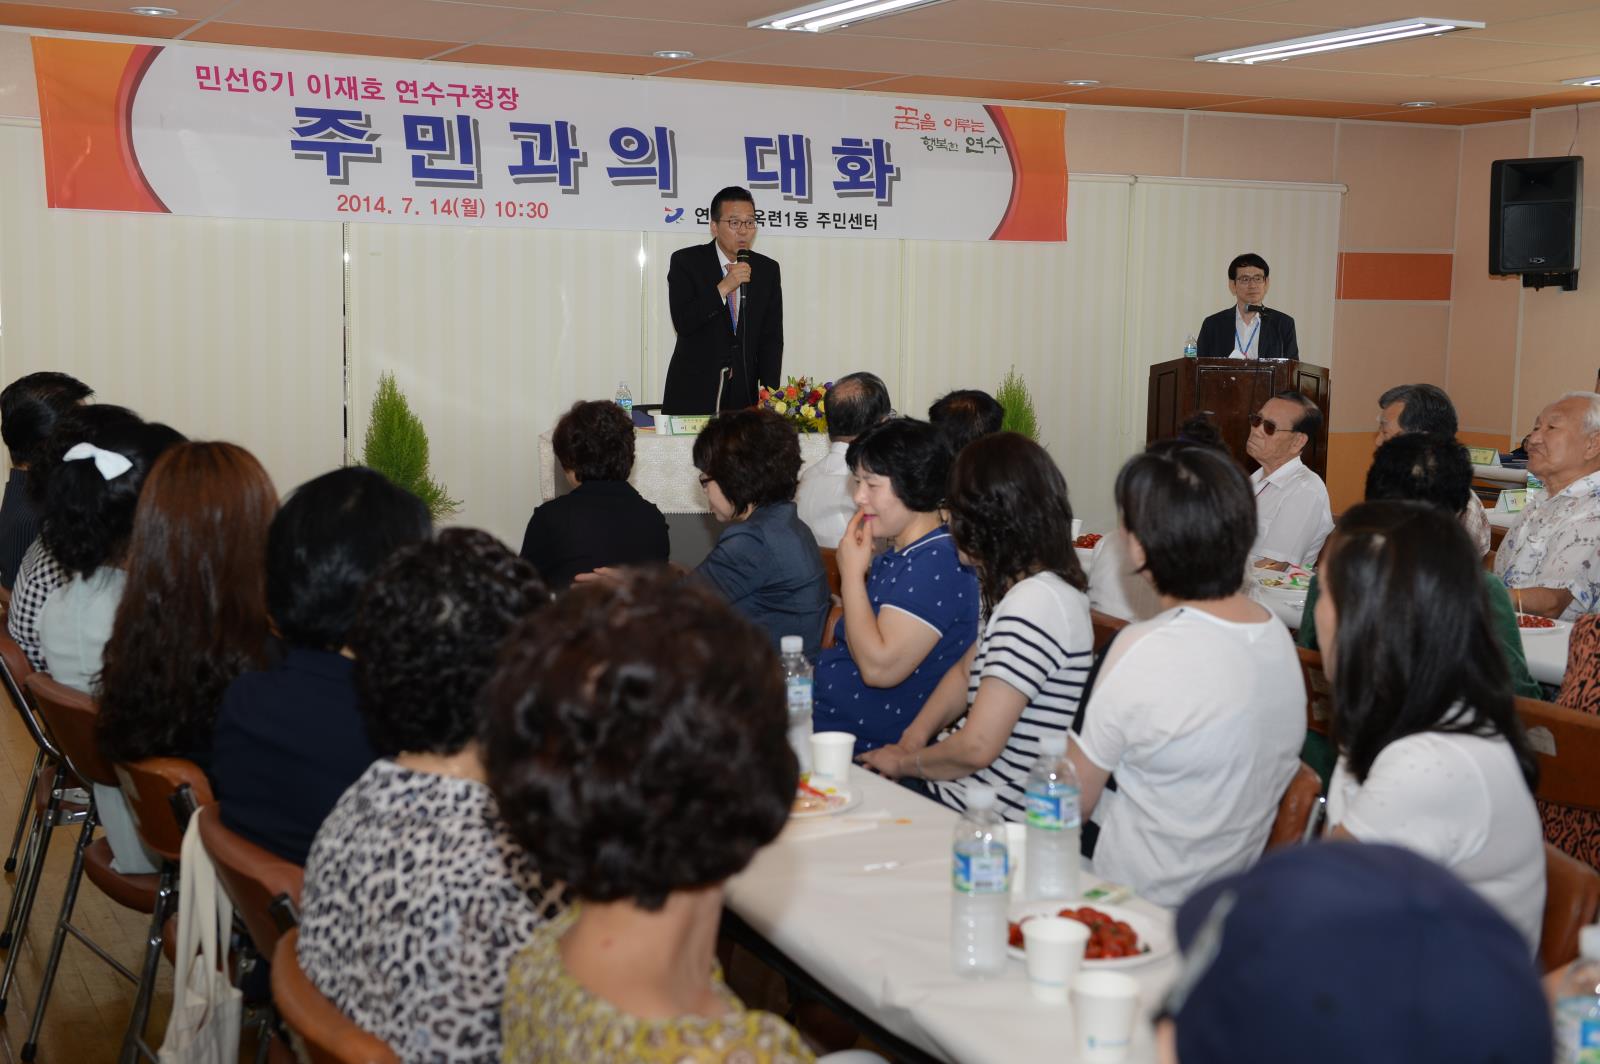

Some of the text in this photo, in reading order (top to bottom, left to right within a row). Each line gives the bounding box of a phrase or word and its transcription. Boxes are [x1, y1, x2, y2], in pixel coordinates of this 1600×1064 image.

[195, 65, 520, 111] 민선6기 이재호 연수구청장
[894, 105, 985, 133] 꿈을 이루는
[290, 106, 901, 206] 주민과의 대화
[919, 135, 1004, 155] 행복한 연수
[337, 194, 549, 219] 2014. 7. 14(월) 10:30
[754, 208, 879, 231] 옥련1동 주민센터
